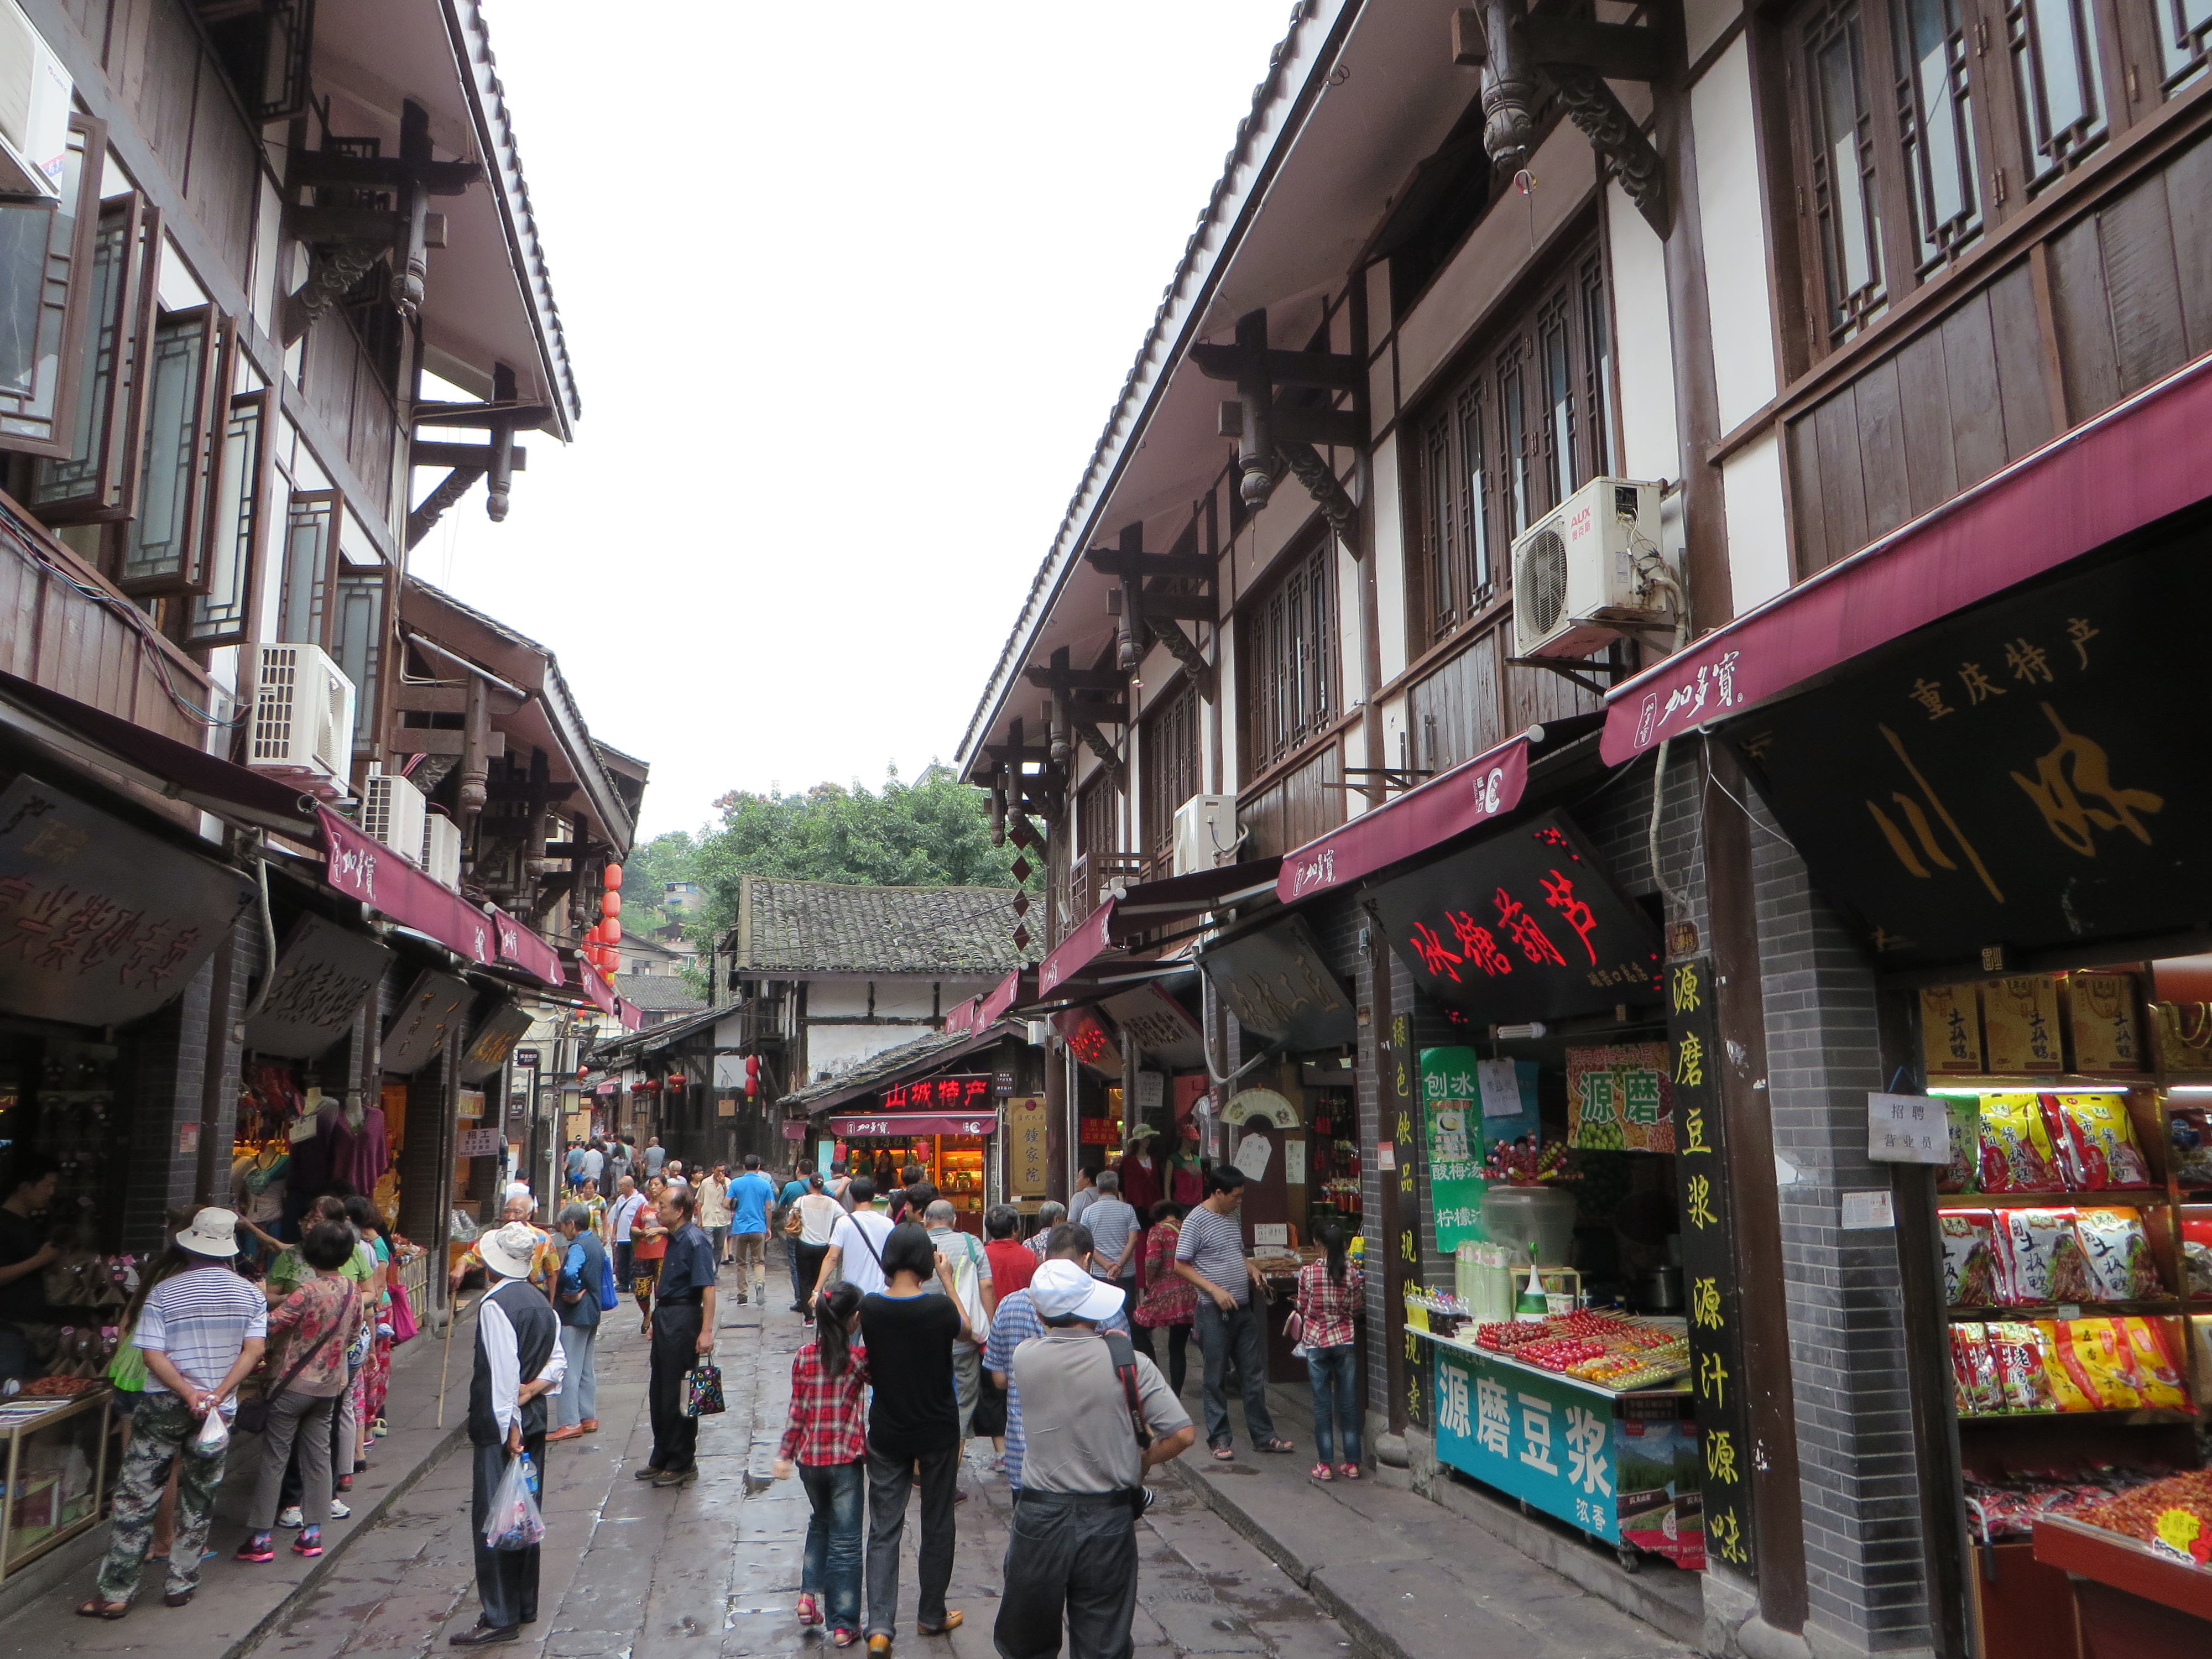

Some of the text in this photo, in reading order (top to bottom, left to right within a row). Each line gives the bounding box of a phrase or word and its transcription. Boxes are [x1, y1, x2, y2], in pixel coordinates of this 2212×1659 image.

[1569, 505, 1592, 528] AUX
[1571, 519, 1592, 542] 奥克斯
[1908, 617, 2100, 719] 重庆特产
[1410, 869, 1597, 983] 冰糖葫芦
[885, 1079, 987, 1108] 山城特产
[1425, 1071, 1475, 1098] 刨冰
[1579, 1067, 1674, 1125] 源磨
[1891, 1104, 1926, 1120] 招聘
[1884, 1134, 1933, 1150] 营业员
[1431, 1161, 1483, 1181] 酸梅汤
[1439, 1360, 1611, 1498] 源磨豆浆
[1575, 1497, 1606, 1532] 浓香
